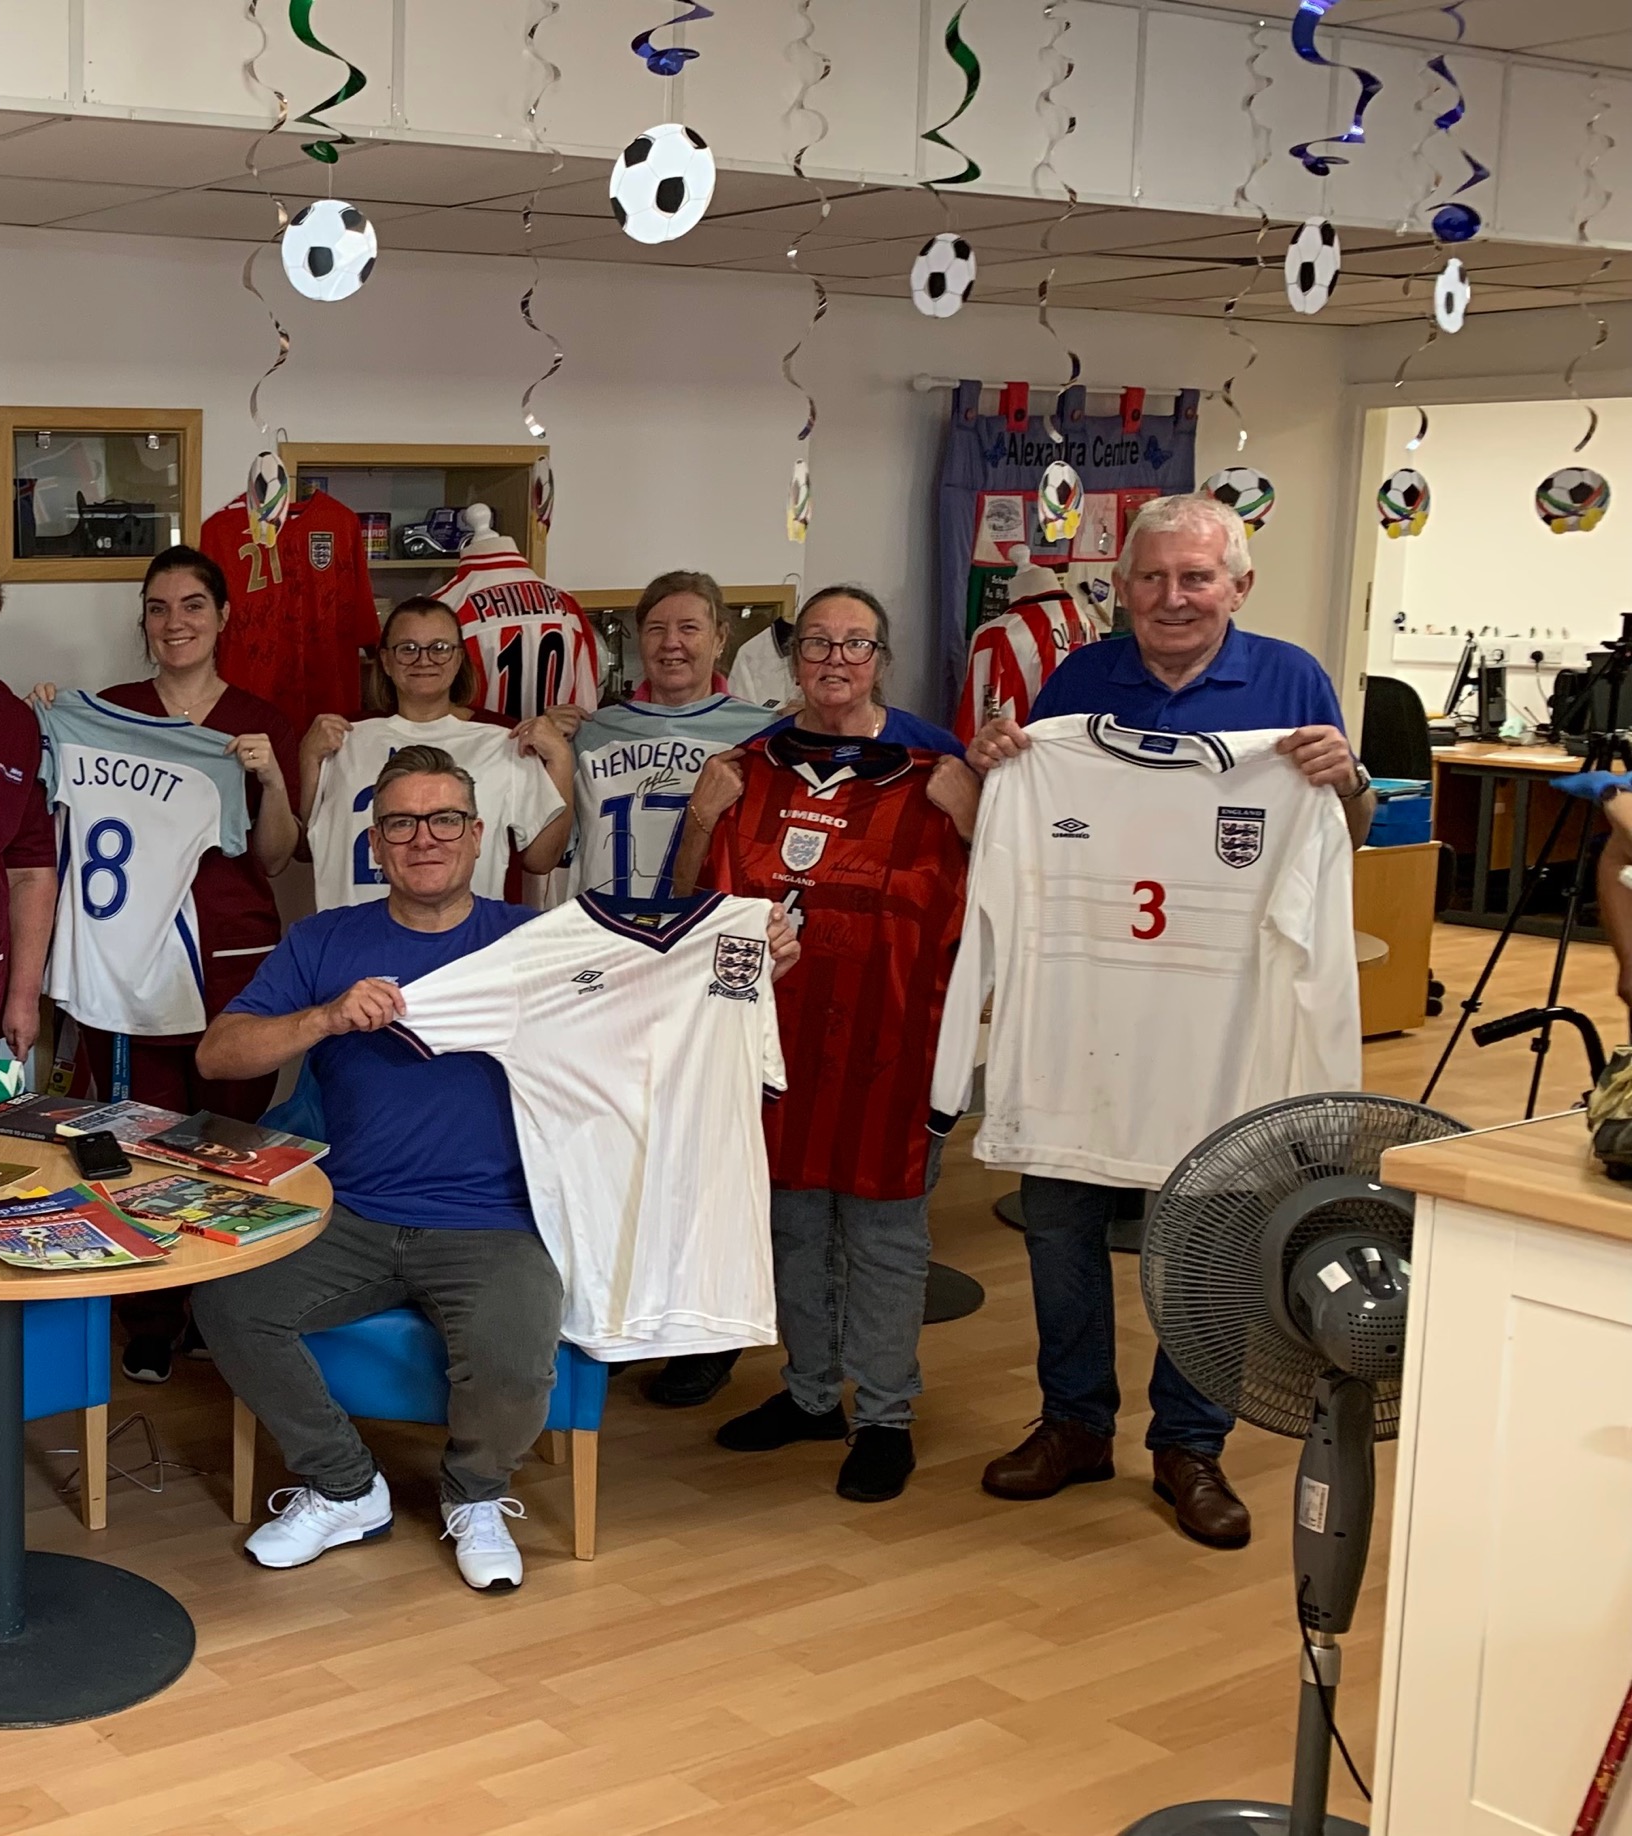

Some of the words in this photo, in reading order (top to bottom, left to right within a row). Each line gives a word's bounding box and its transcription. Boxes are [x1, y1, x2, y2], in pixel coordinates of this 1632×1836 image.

[1092, 437, 1140, 466] Centre
[238, 543, 283, 594] 21
[468, 582, 568, 623] PHILLIPS
[497, 631, 565, 717] 10
[72, 757, 184, 802] J.SCOTT
[779, 809, 848, 829] UMBRO
[1220, 808, 1263, 817] ENGLAND
[600, 793, 692, 899] 17
[1052, 832, 1090, 840] UMBRO
[81, 817, 135, 920] 8
[772, 872, 816, 888] ENGLAND
[1131, 880, 1167, 940] 3
[26, 1132, 46, 1140] LEGEND
[9, 1198, 57, 1212] Stories
[33, 1210, 81, 1223] Stories
